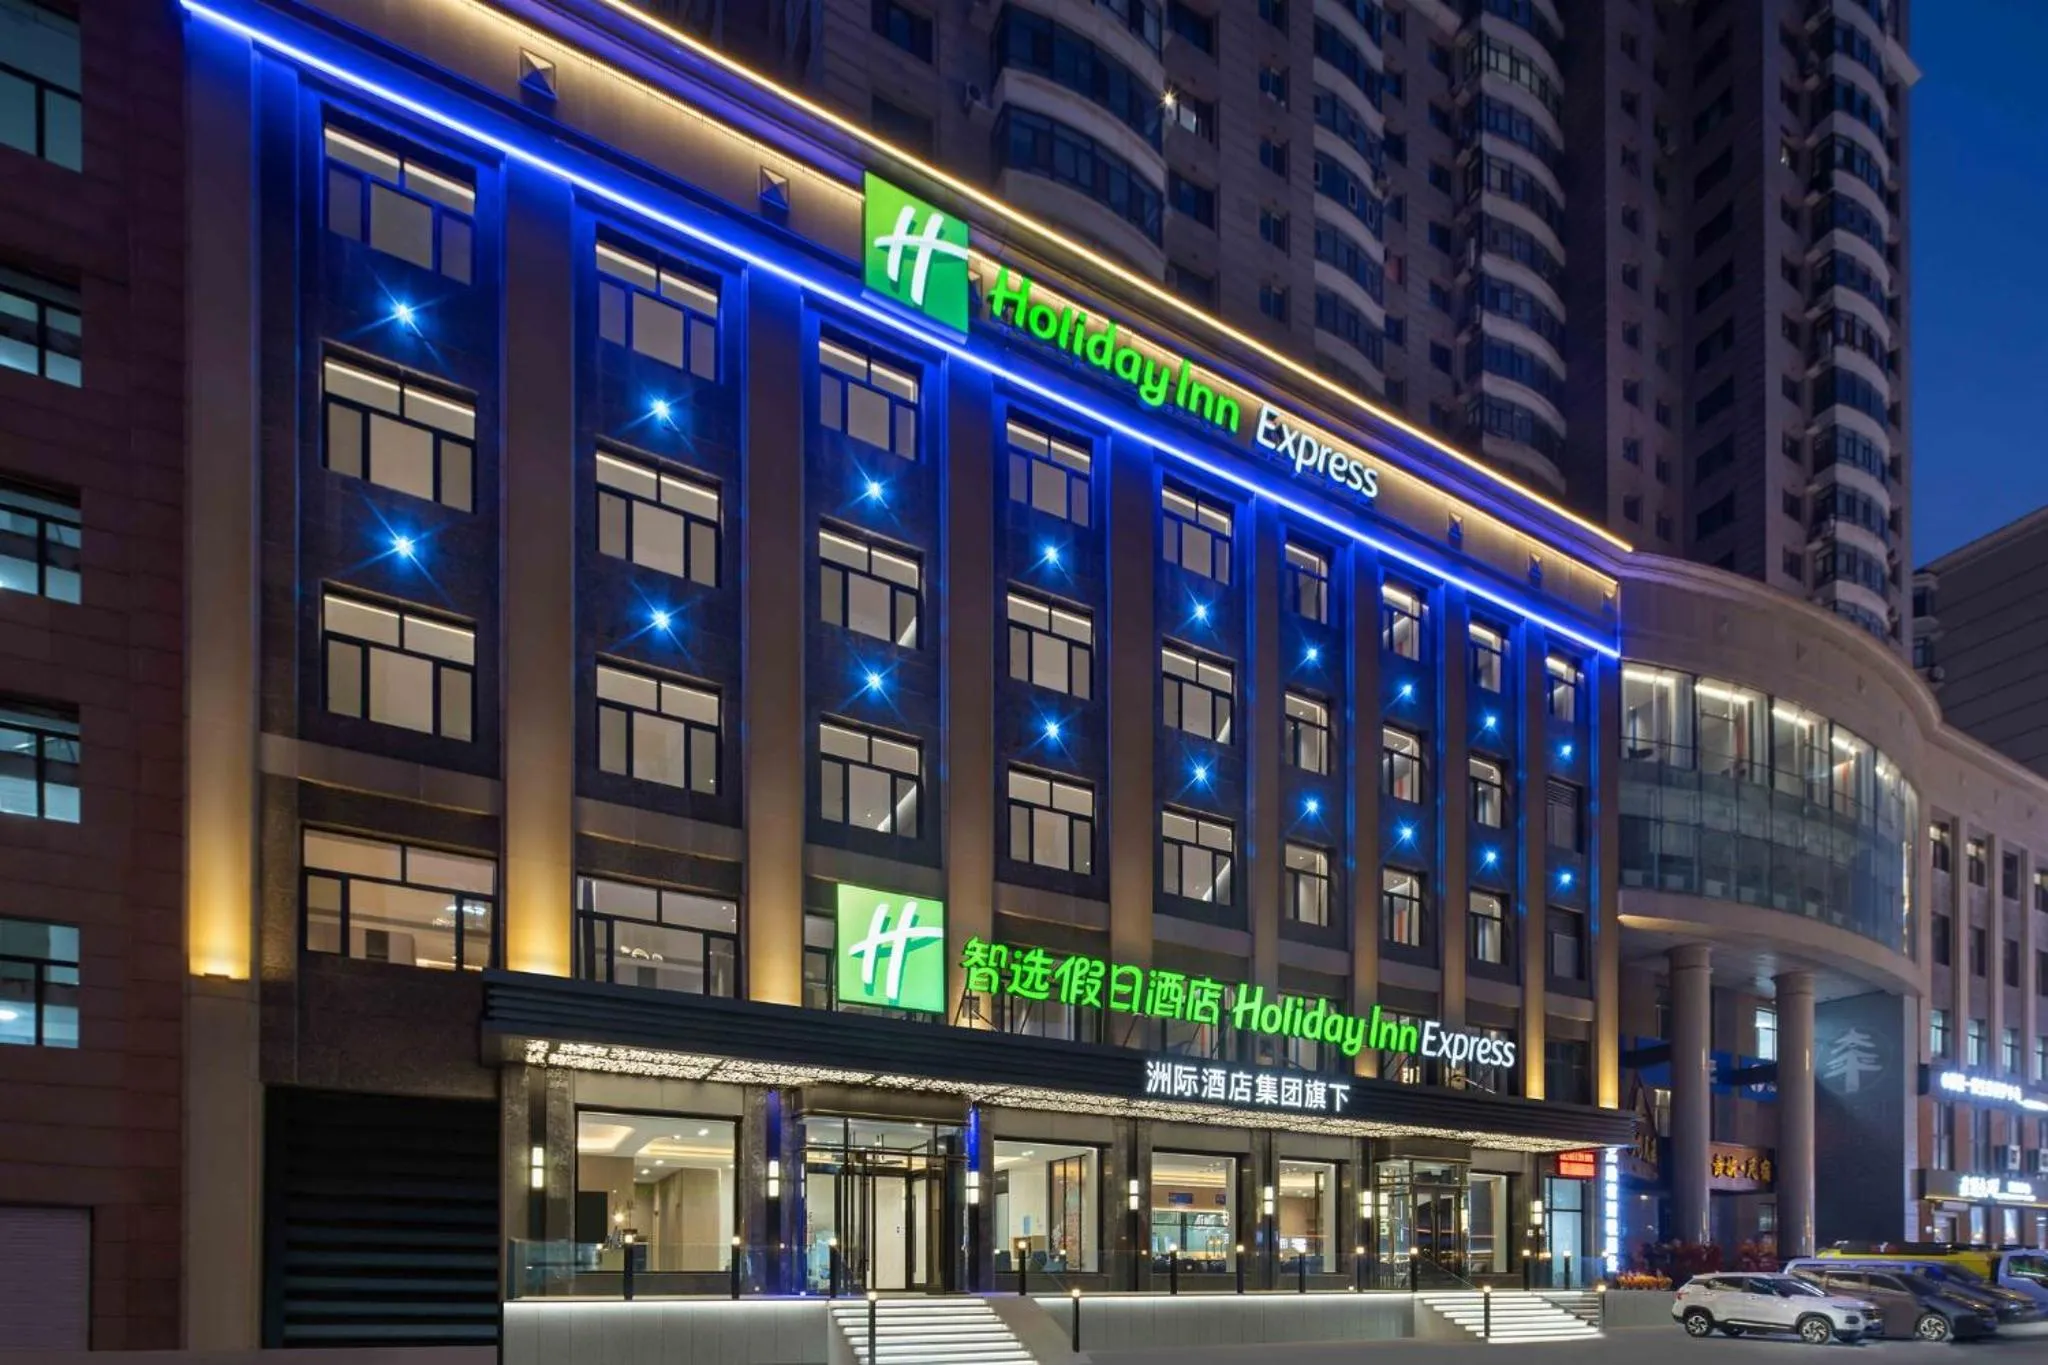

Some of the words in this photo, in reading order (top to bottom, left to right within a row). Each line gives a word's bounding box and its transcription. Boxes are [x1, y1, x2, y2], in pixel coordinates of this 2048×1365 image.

[988, 267, 1171, 406] Holiday
[1176, 360, 1241, 433] Inn
[1255, 401, 1381, 500] Express
[962, 936, 1225, 1026] 智选假日酒店
[1231, 982, 1367, 1057] Holiday
[1367, 1005, 1419, 1054] Inn
[1421, 1020, 1517, 1069] Express
[1145, 1060, 1352, 1113] 洲际酒店集团旗下
